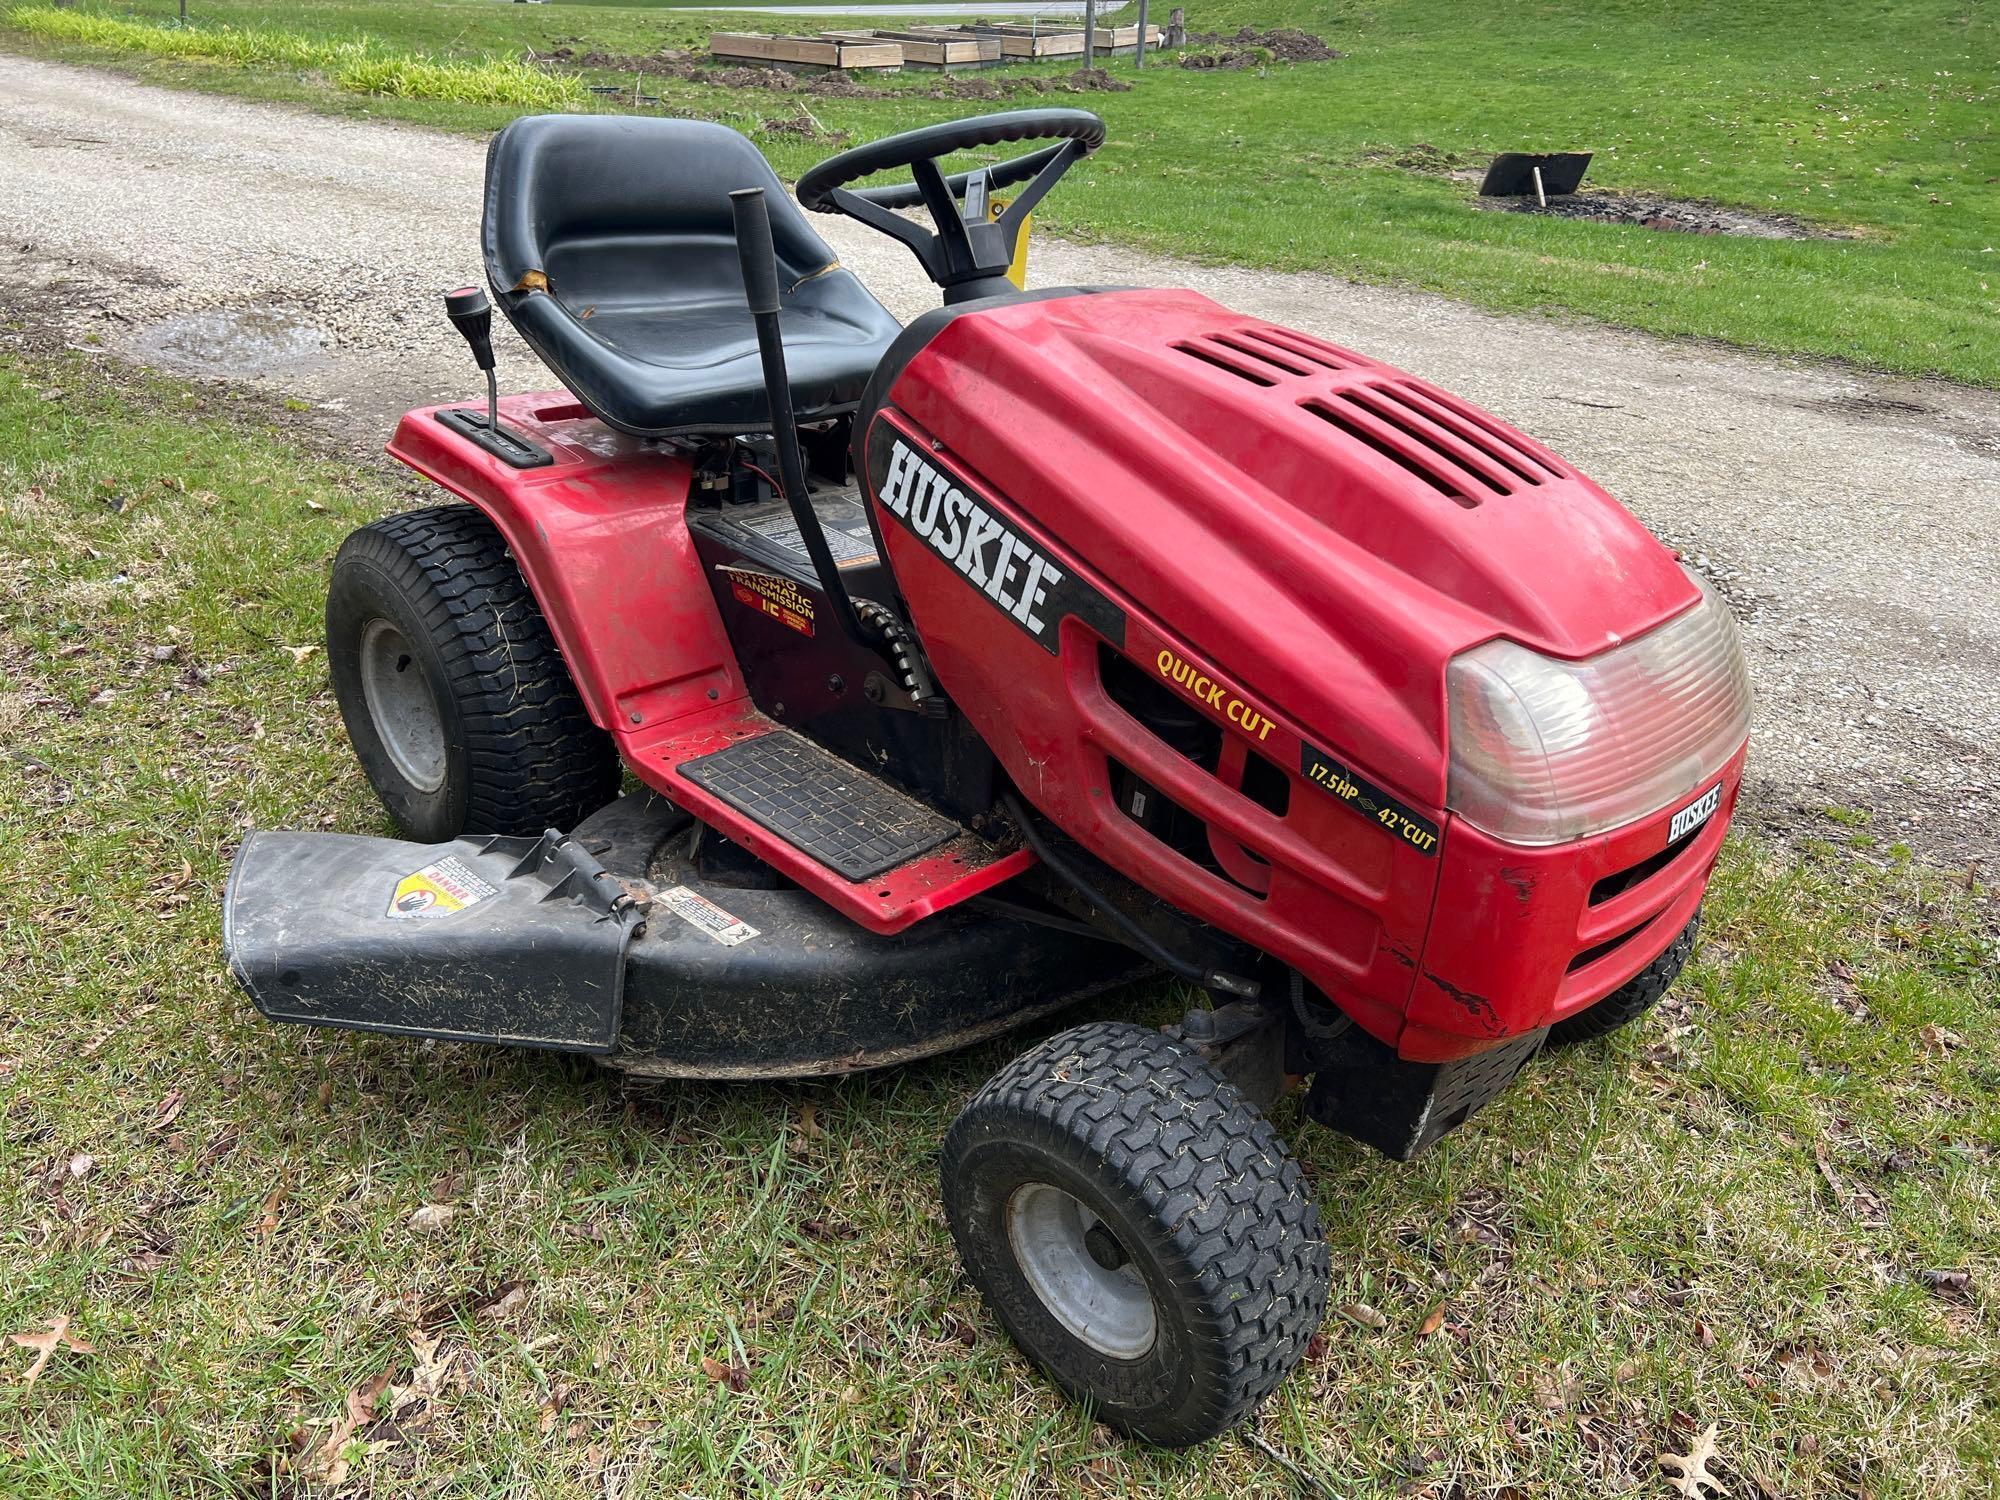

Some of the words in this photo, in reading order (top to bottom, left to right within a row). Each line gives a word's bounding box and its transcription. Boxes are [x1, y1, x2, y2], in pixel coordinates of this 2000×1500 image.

[880, 440, 1062, 635] HUSKEE
[729, 574, 814, 619] TRANSMISSION
[1157, 650, 1226, 711] QUICK
[1226, 699, 1276, 741] CUT
[1309, 762, 1359, 800] 17.5HP
[1668, 782, 1721, 844] HUSKEE
[428, 871, 470, 900] DANGER
